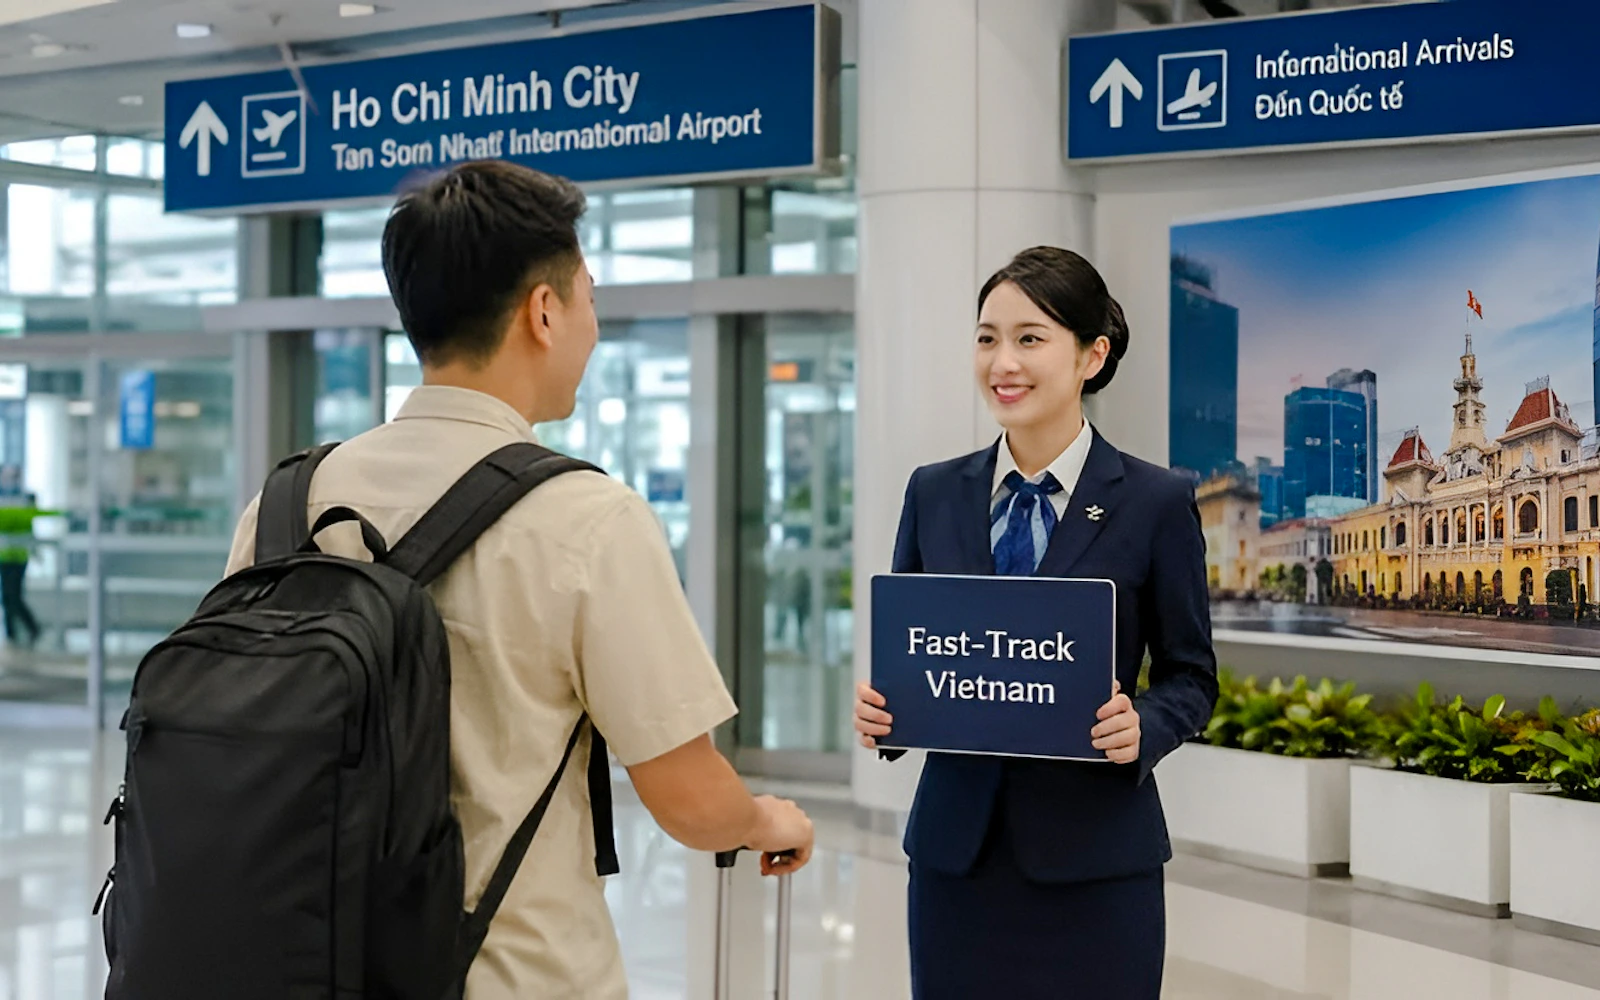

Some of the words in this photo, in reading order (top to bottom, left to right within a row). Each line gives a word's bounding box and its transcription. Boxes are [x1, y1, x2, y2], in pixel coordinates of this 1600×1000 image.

[1415, 32, 1514, 66] Arrivals
[332, 88, 381, 130] Ho
[391, 79, 451, 124] Chi
[463, 73, 552, 118] Minh
[563, 65, 640, 114] City
[676, 108, 762, 144] Airport
[907, 627, 1075, 662] Fast-Track
[925, 670, 1055, 704] Vietnam
